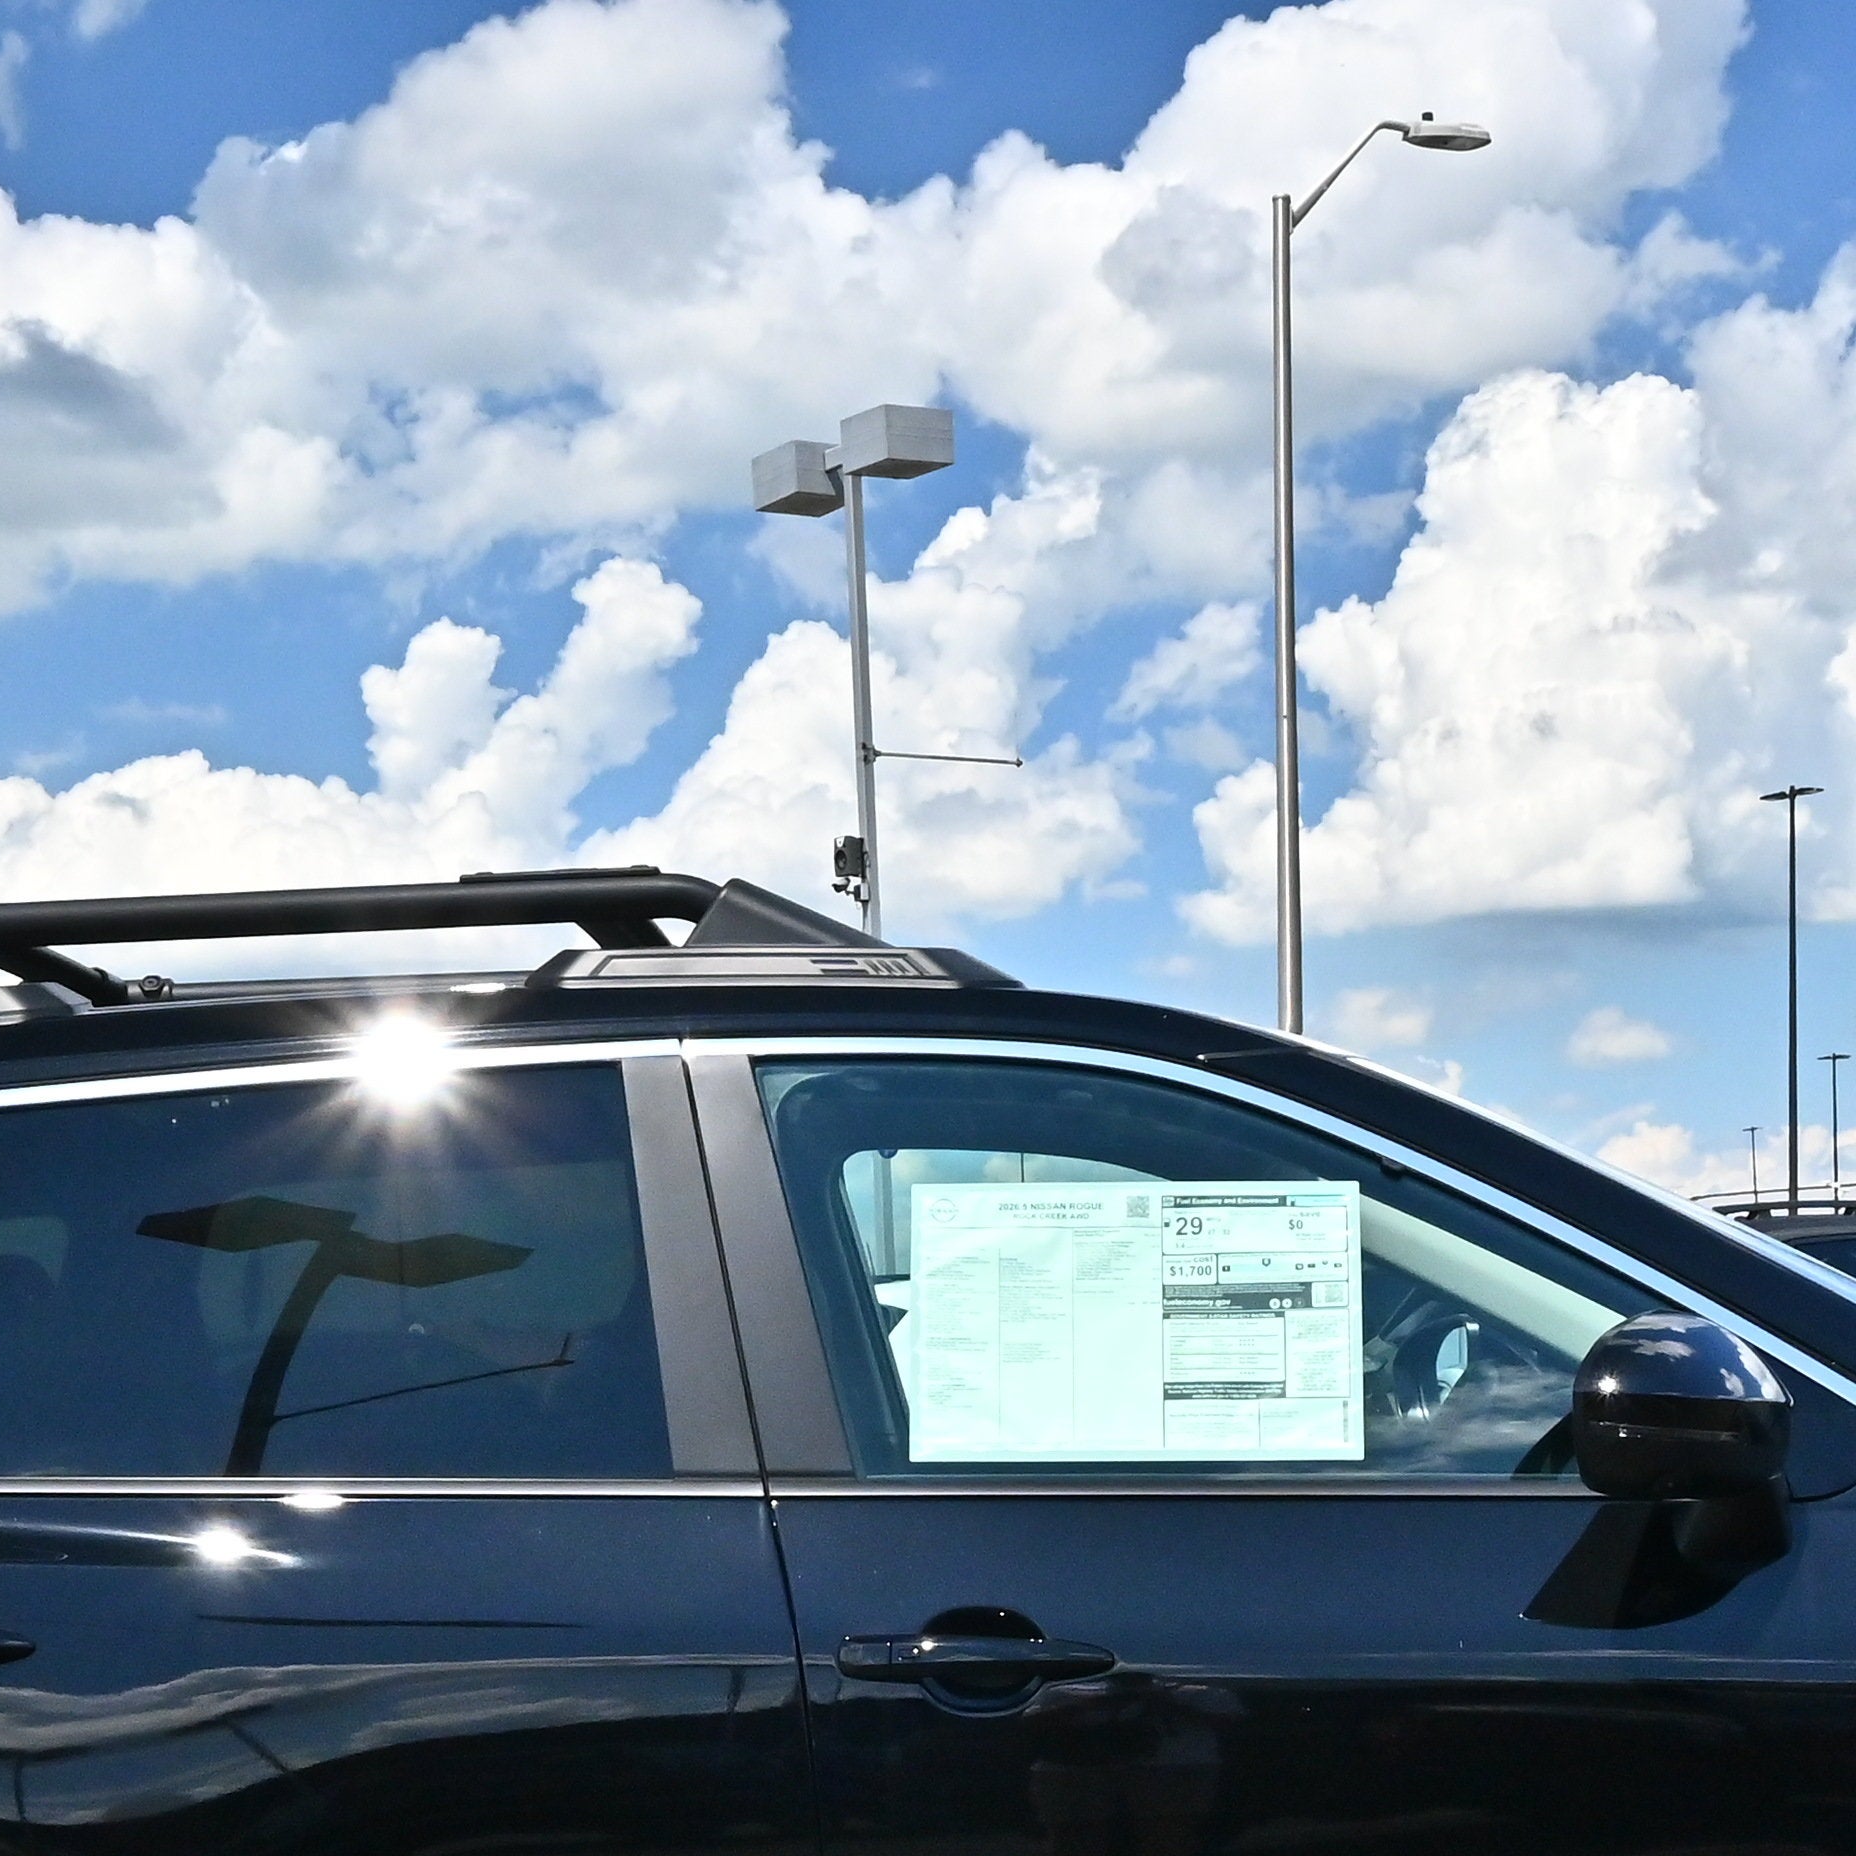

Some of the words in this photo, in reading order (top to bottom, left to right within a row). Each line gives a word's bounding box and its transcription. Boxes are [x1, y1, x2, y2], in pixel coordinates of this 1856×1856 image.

[1175, 1216, 1203, 1236] 29
[1288, 1219, 1304, 1230] $0
[1169, 1265, 1213, 1278] $1,700
